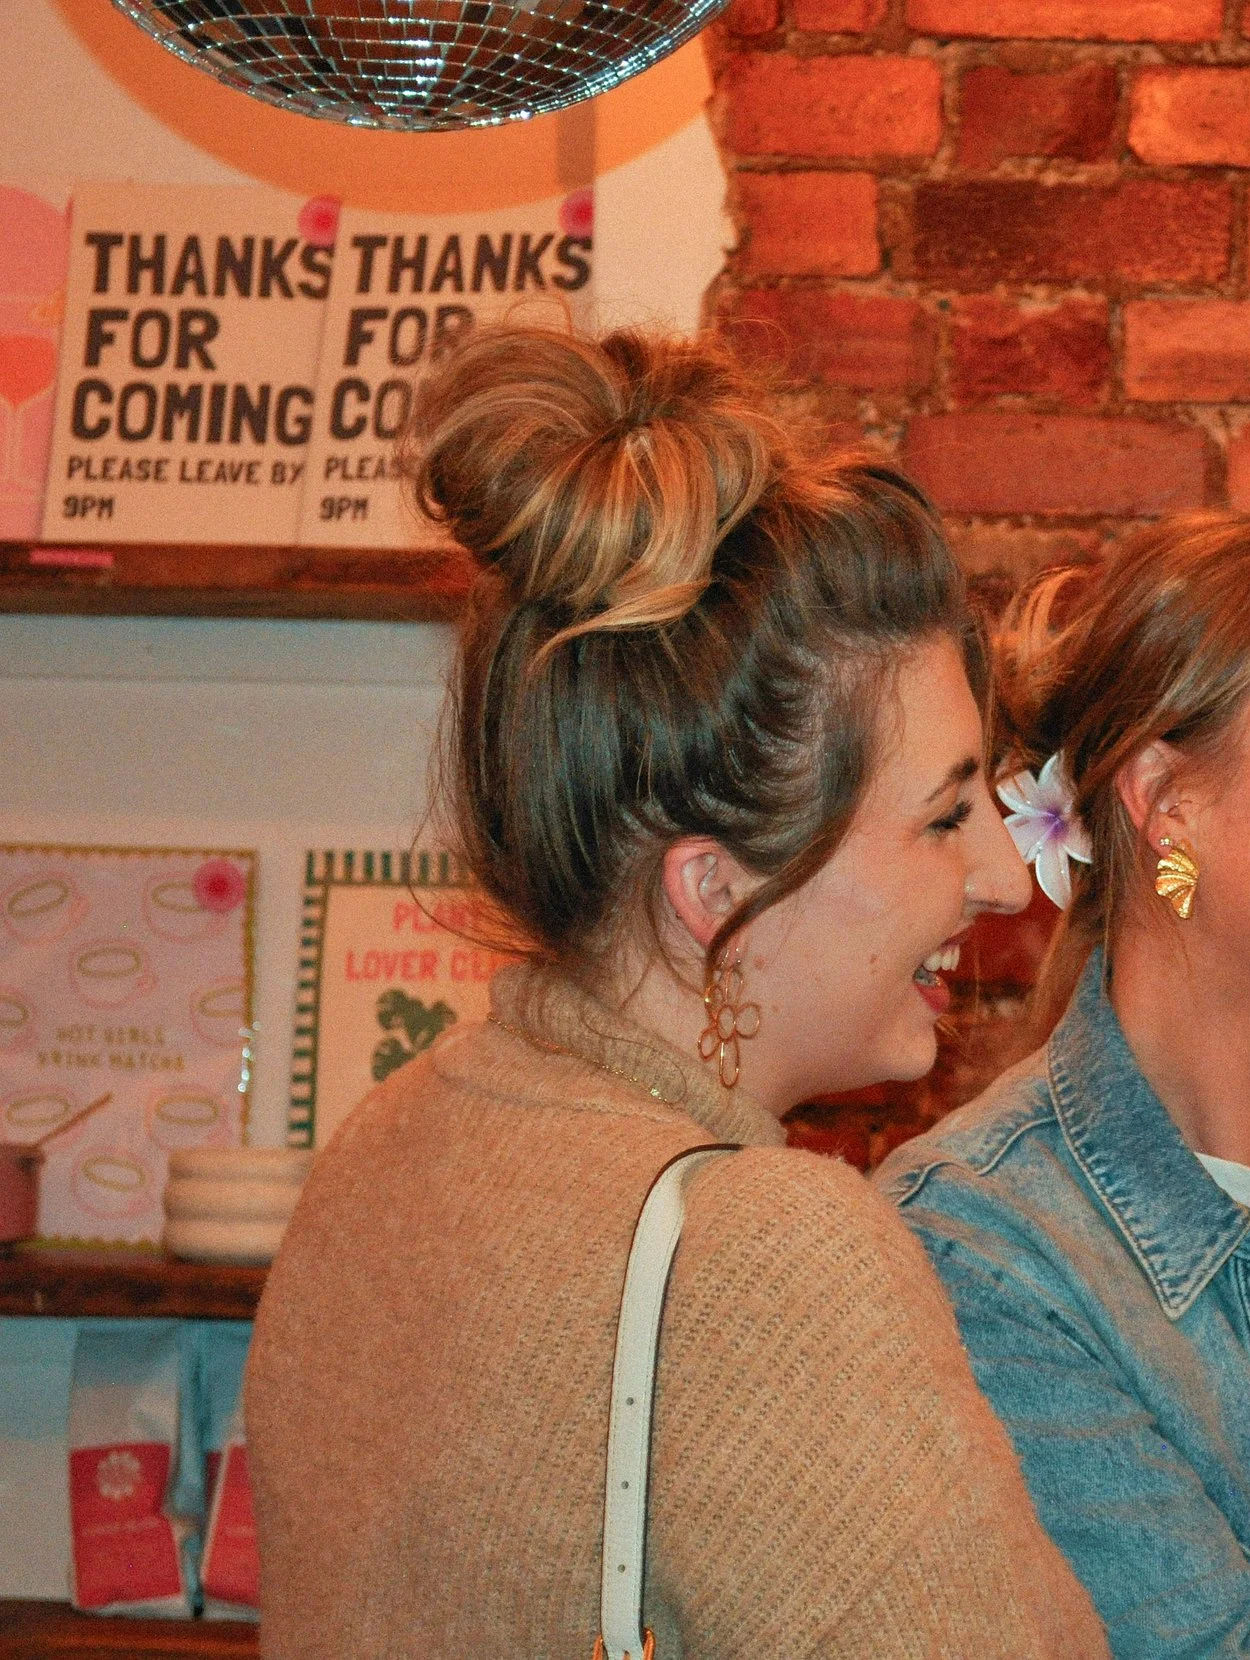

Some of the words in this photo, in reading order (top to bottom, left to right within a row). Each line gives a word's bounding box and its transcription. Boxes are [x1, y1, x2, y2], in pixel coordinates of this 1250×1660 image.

[85, 232, 335, 299] THANKS
[352, 232, 593, 294] THANKS
[84, 307, 221, 371] FOR
[71, 377, 315, 447] COMING
[66, 455, 171, 483] PLEASE
[178, 457, 263, 485] LEAVE
[270, 460, 306, 486] BY
[62, 495, 116, 520] 9PM
[317, 497, 369, 521] 9PM
[344, 948, 440, 984] LOVER
